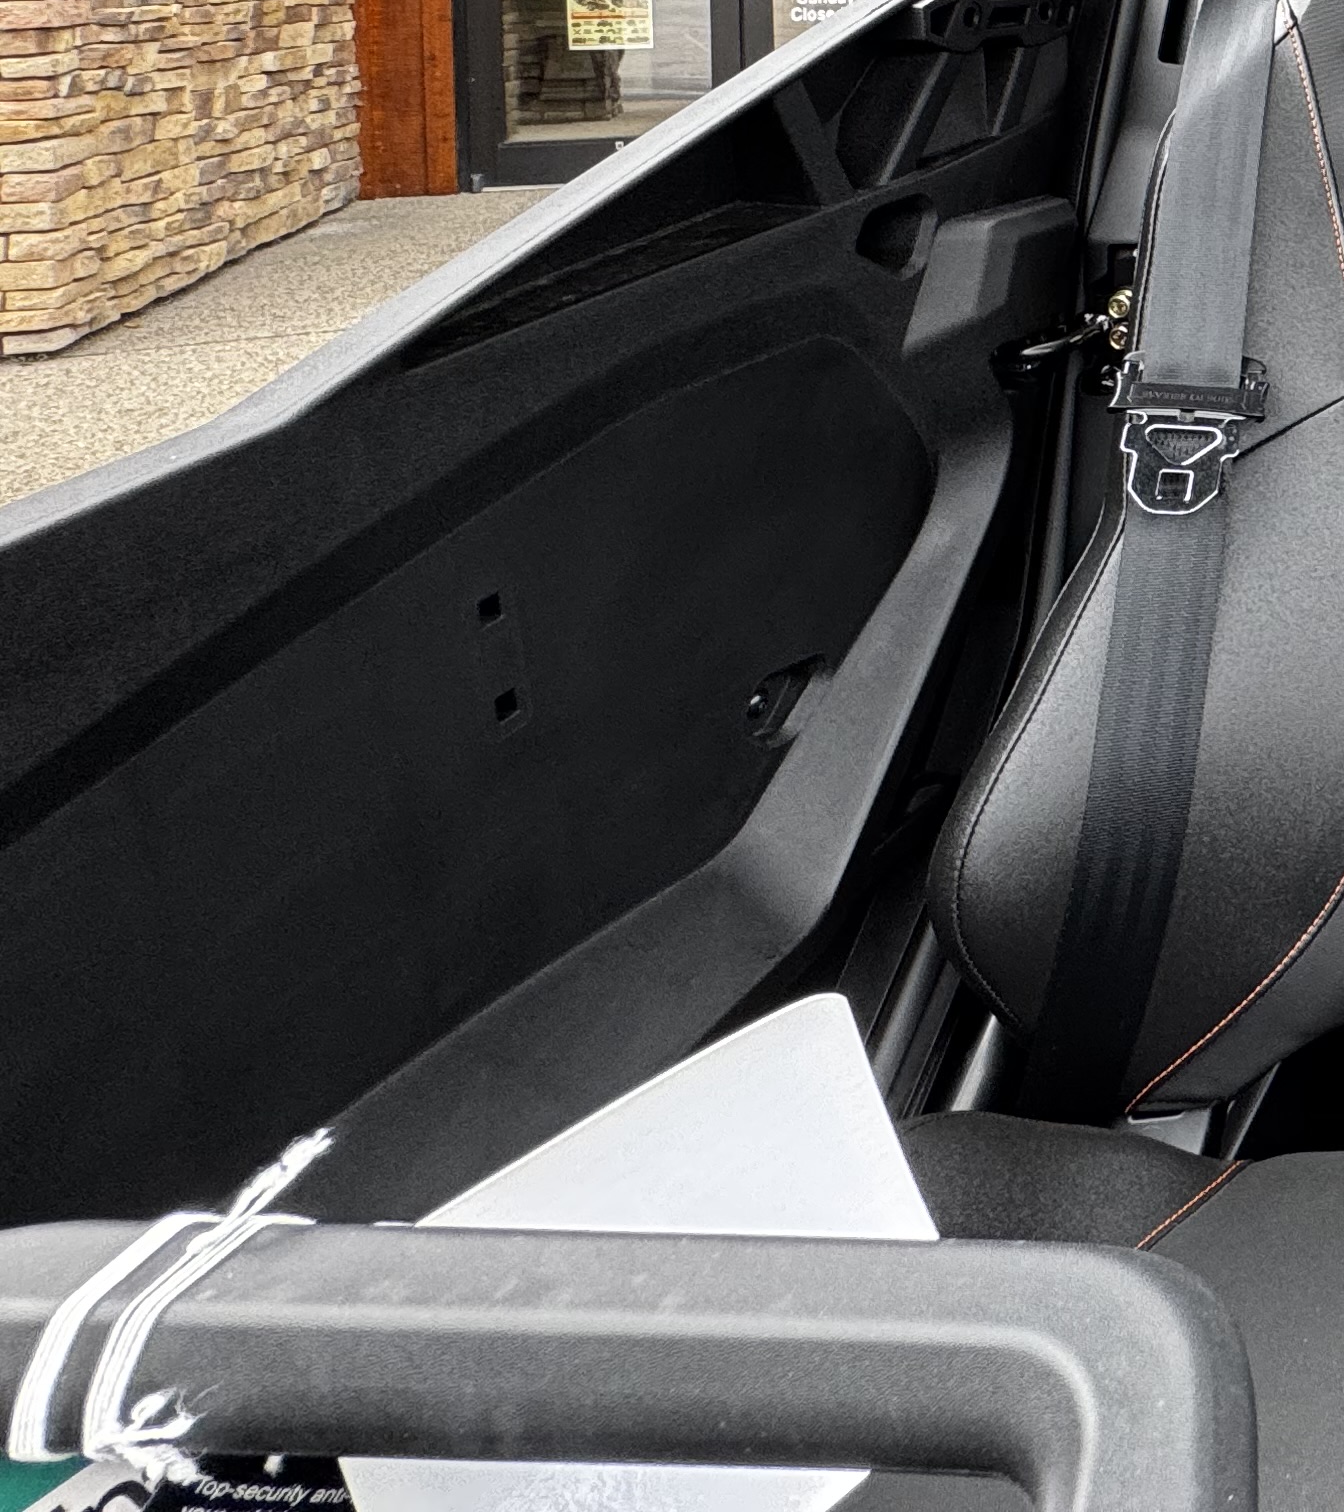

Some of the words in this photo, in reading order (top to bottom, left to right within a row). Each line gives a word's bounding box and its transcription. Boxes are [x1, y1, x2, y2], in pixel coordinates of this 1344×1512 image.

[790, 7, 835, 22] Close
[195, 1478, 309, 1507] Top-security
[309, 1488, 352, 1504] anti-
